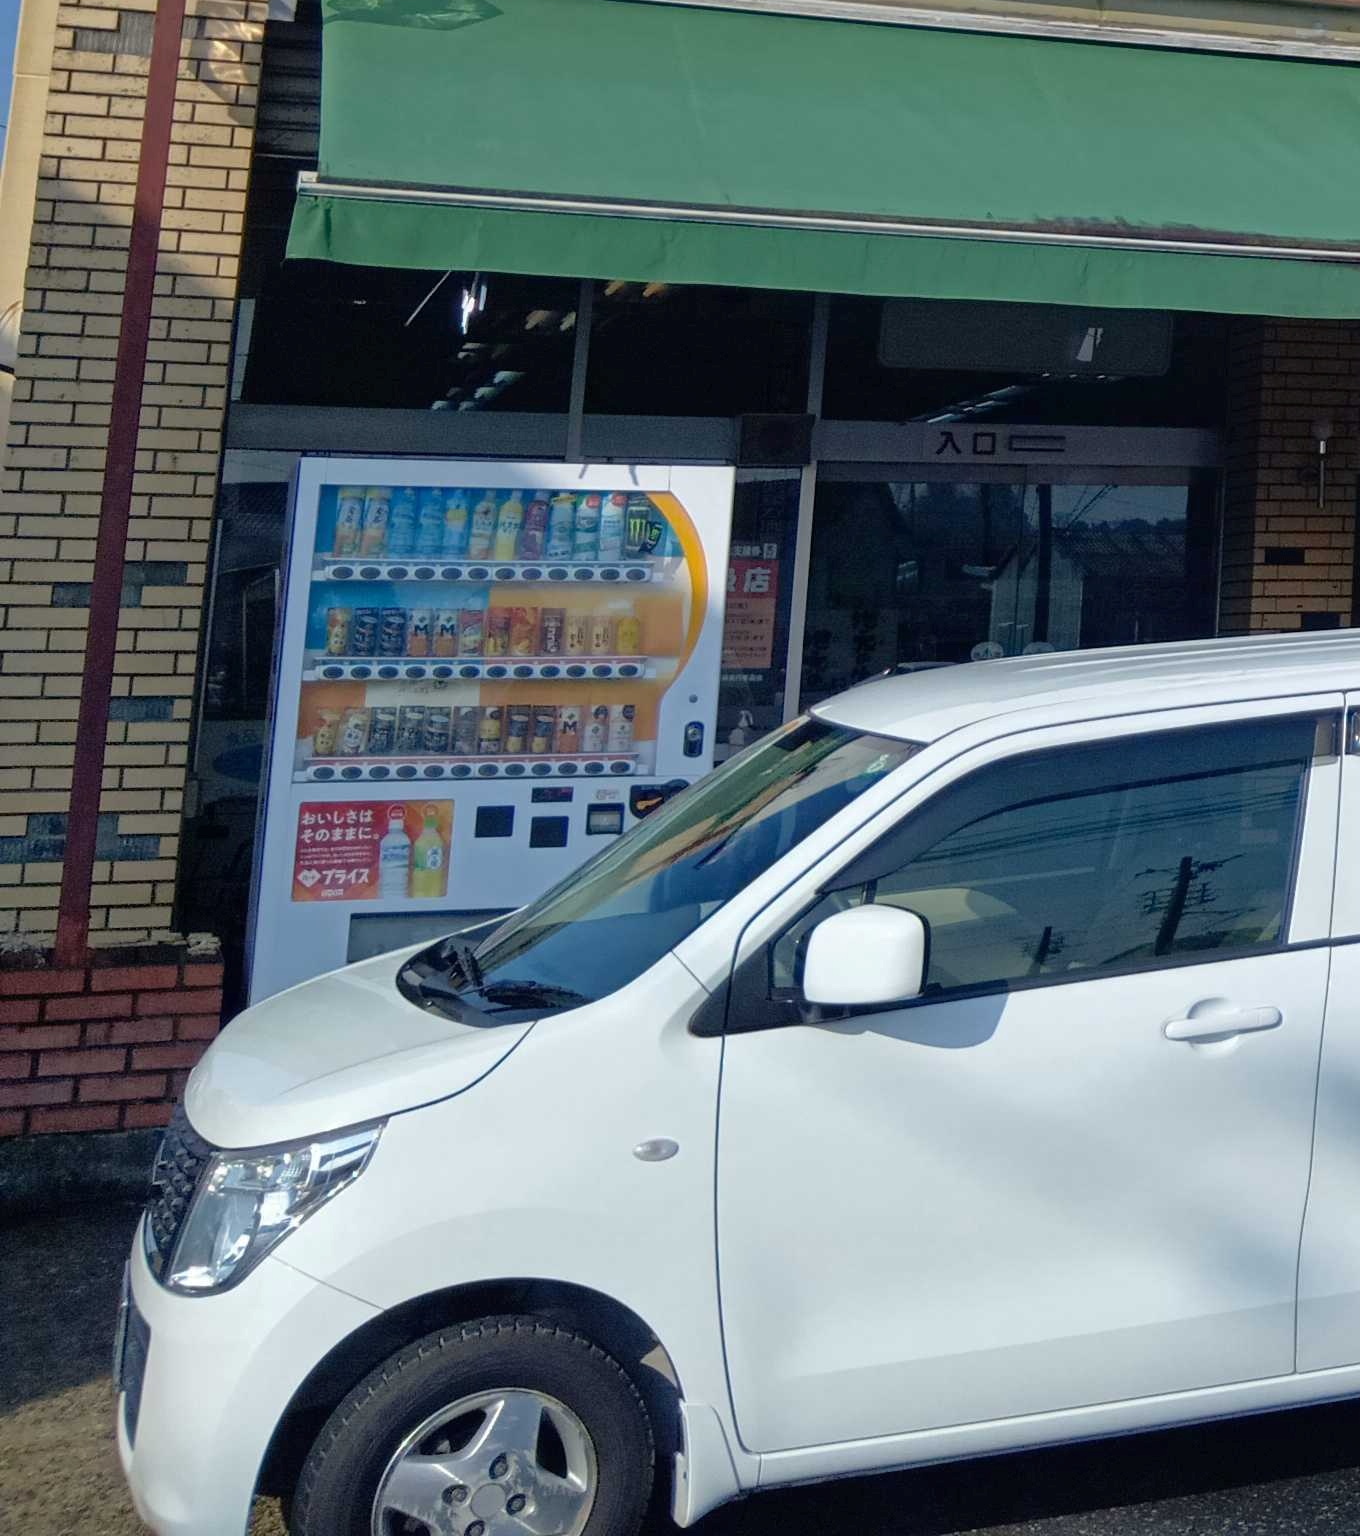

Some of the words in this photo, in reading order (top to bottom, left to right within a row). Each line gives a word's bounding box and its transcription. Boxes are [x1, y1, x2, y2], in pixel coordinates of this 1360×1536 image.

[935, 431, 997, 455] 入口
[301, 809, 375, 825] おいしさは
[300, 827, 380, 843] そのままに。
